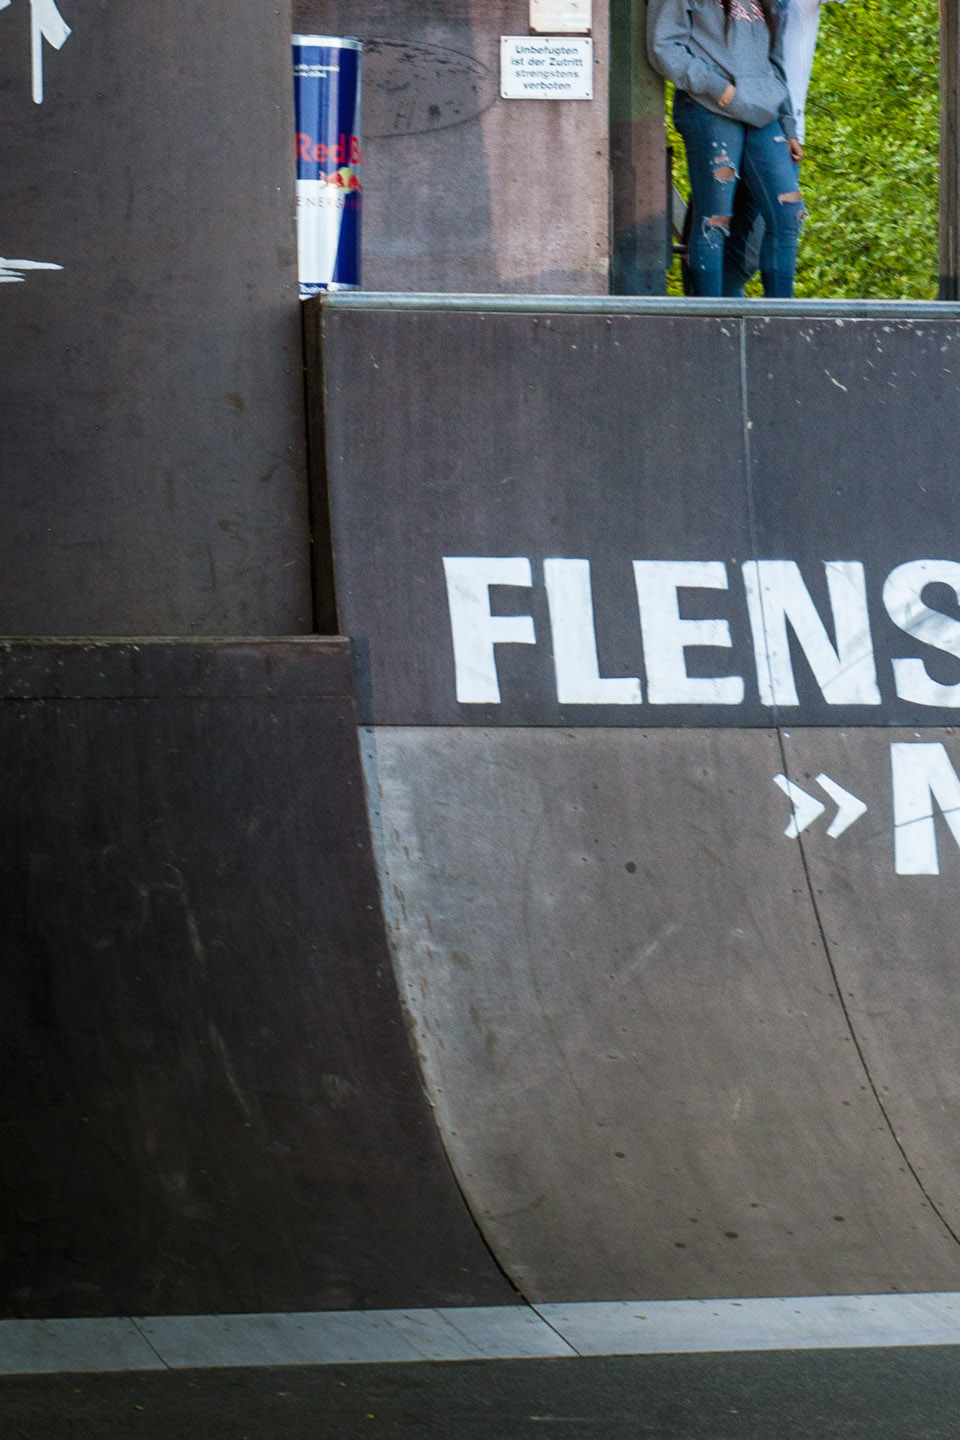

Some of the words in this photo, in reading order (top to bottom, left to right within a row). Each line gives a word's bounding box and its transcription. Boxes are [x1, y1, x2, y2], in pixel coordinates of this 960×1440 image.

[515, 45, 579, 56] Unbefugten
[511, 58, 525, 66] ist
[528, 58, 545, 66] der
[549, 57, 584, 67] Zutritt
[515, 69, 579, 79] strengstens
[523, 81, 572, 90] verboten
[294, 133, 346, 164] Red
